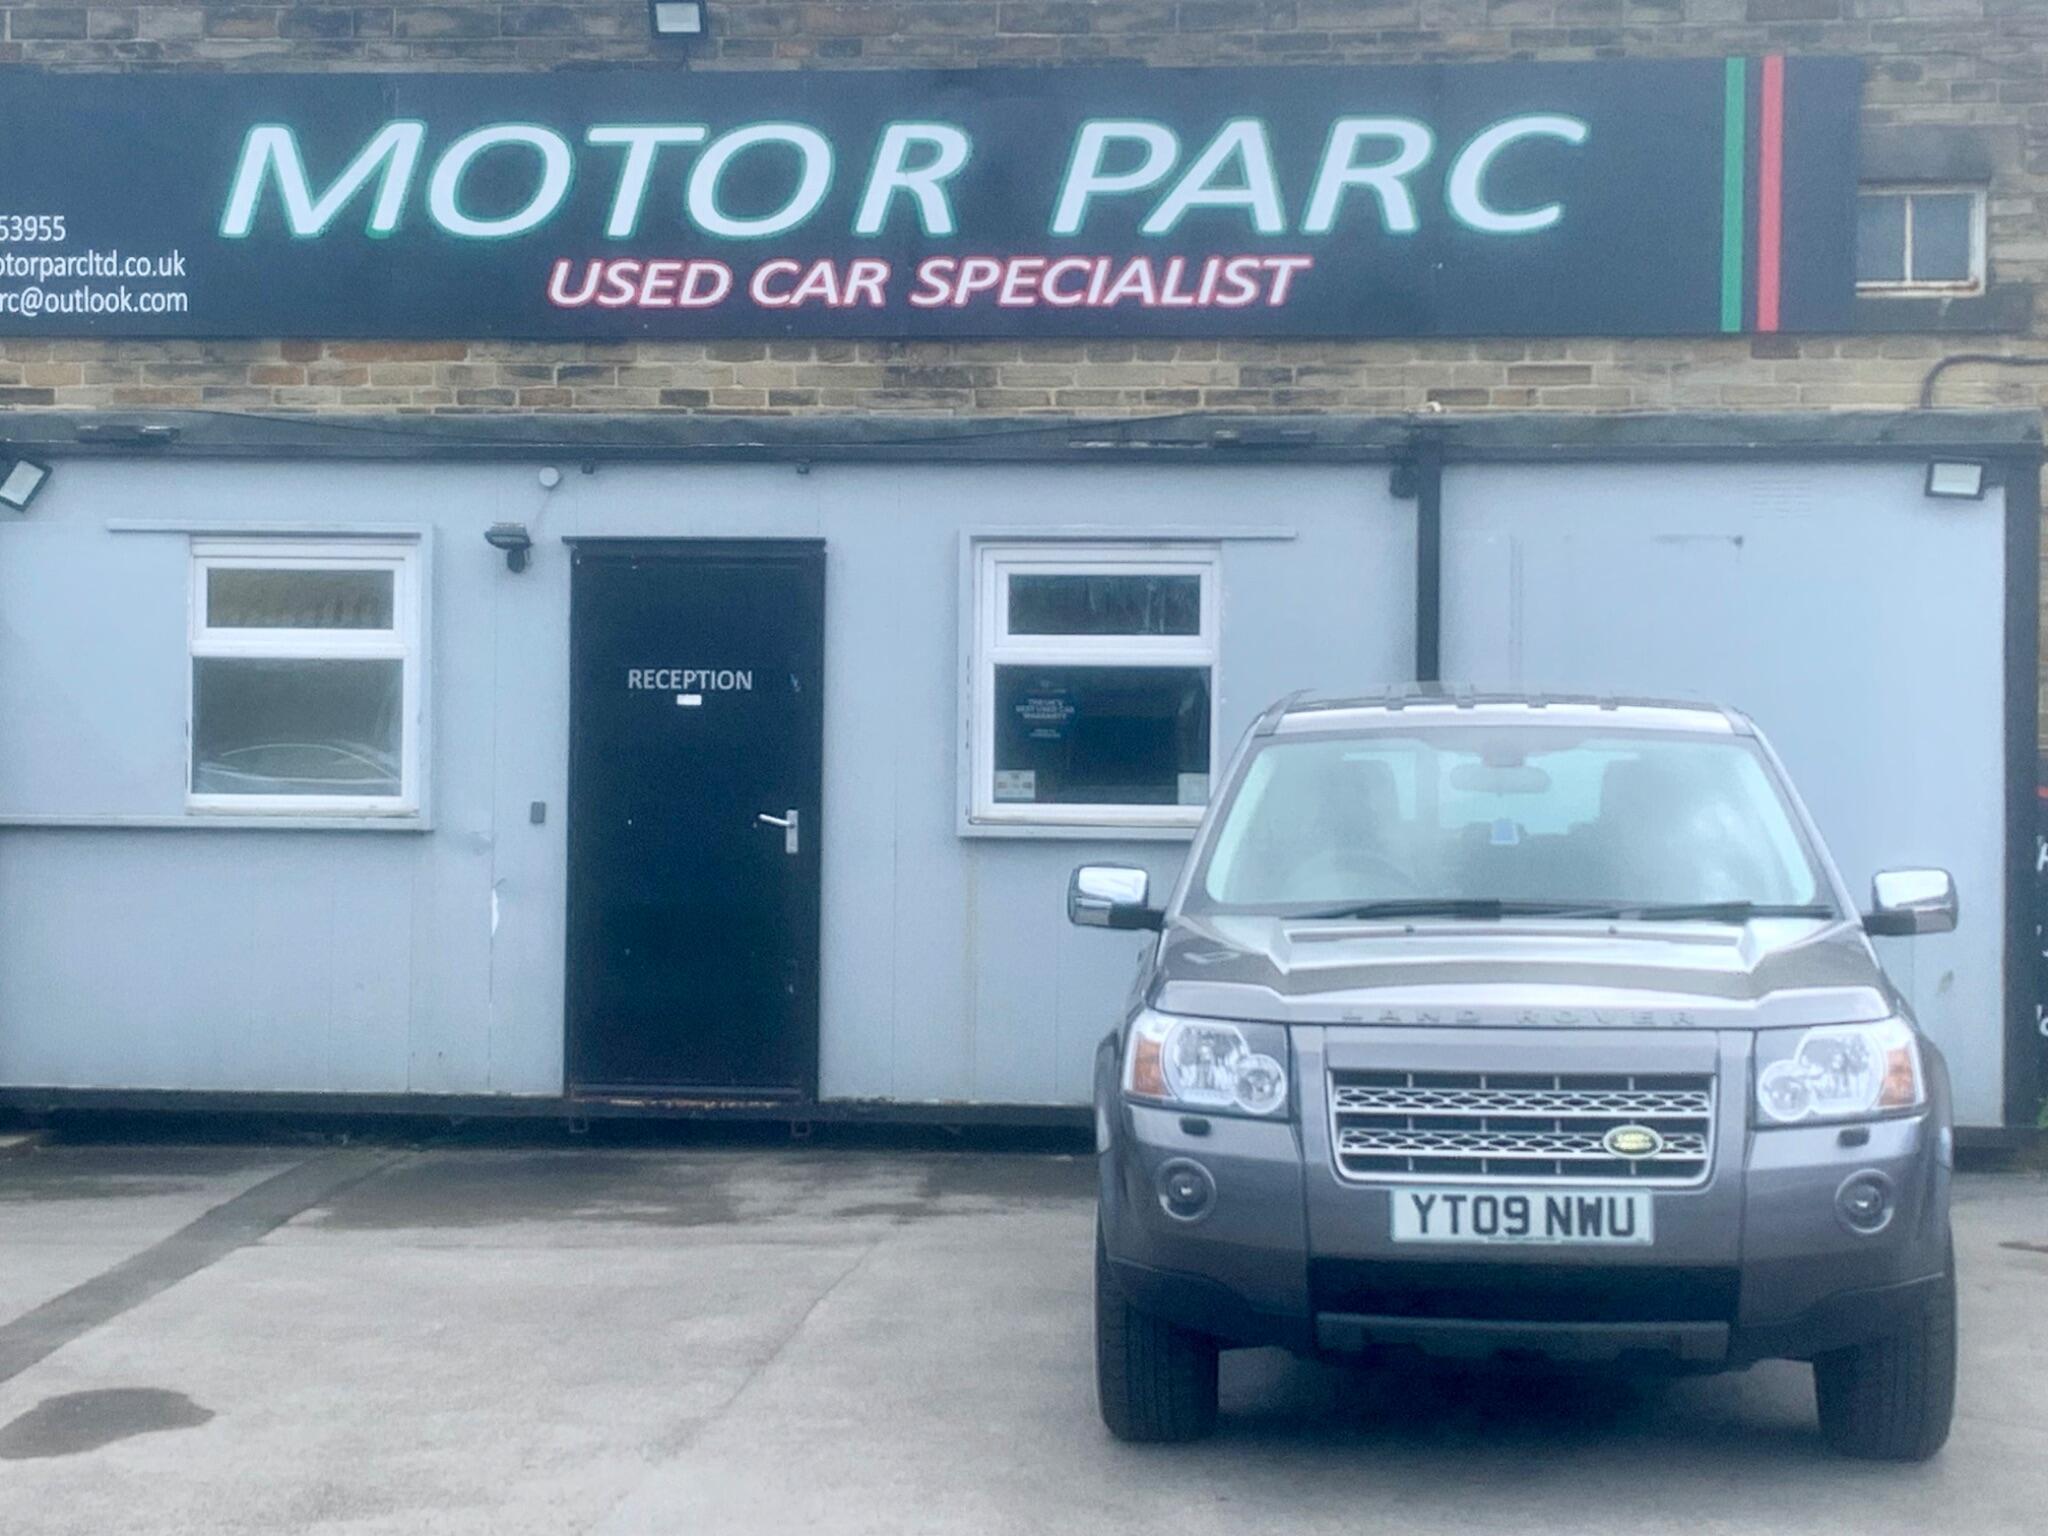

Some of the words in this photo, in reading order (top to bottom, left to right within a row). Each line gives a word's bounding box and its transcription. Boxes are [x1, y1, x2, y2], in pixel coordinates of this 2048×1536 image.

[219, 118, 971, 239] MOTOR
[1048, 115, 1590, 236] PARC
[0, 285, 188, 317] rc@outlook.com
[548, 258, 732, 308] USED
[750, 257, 890, 308] CAR
[909, 255, 1313, 308] SPECIALIST
[628, 669, 753, 690] RECEPTION
[1411, 1194, 1531, 1236] YT09
[1545, 1195, 1635, 1237] NWU
